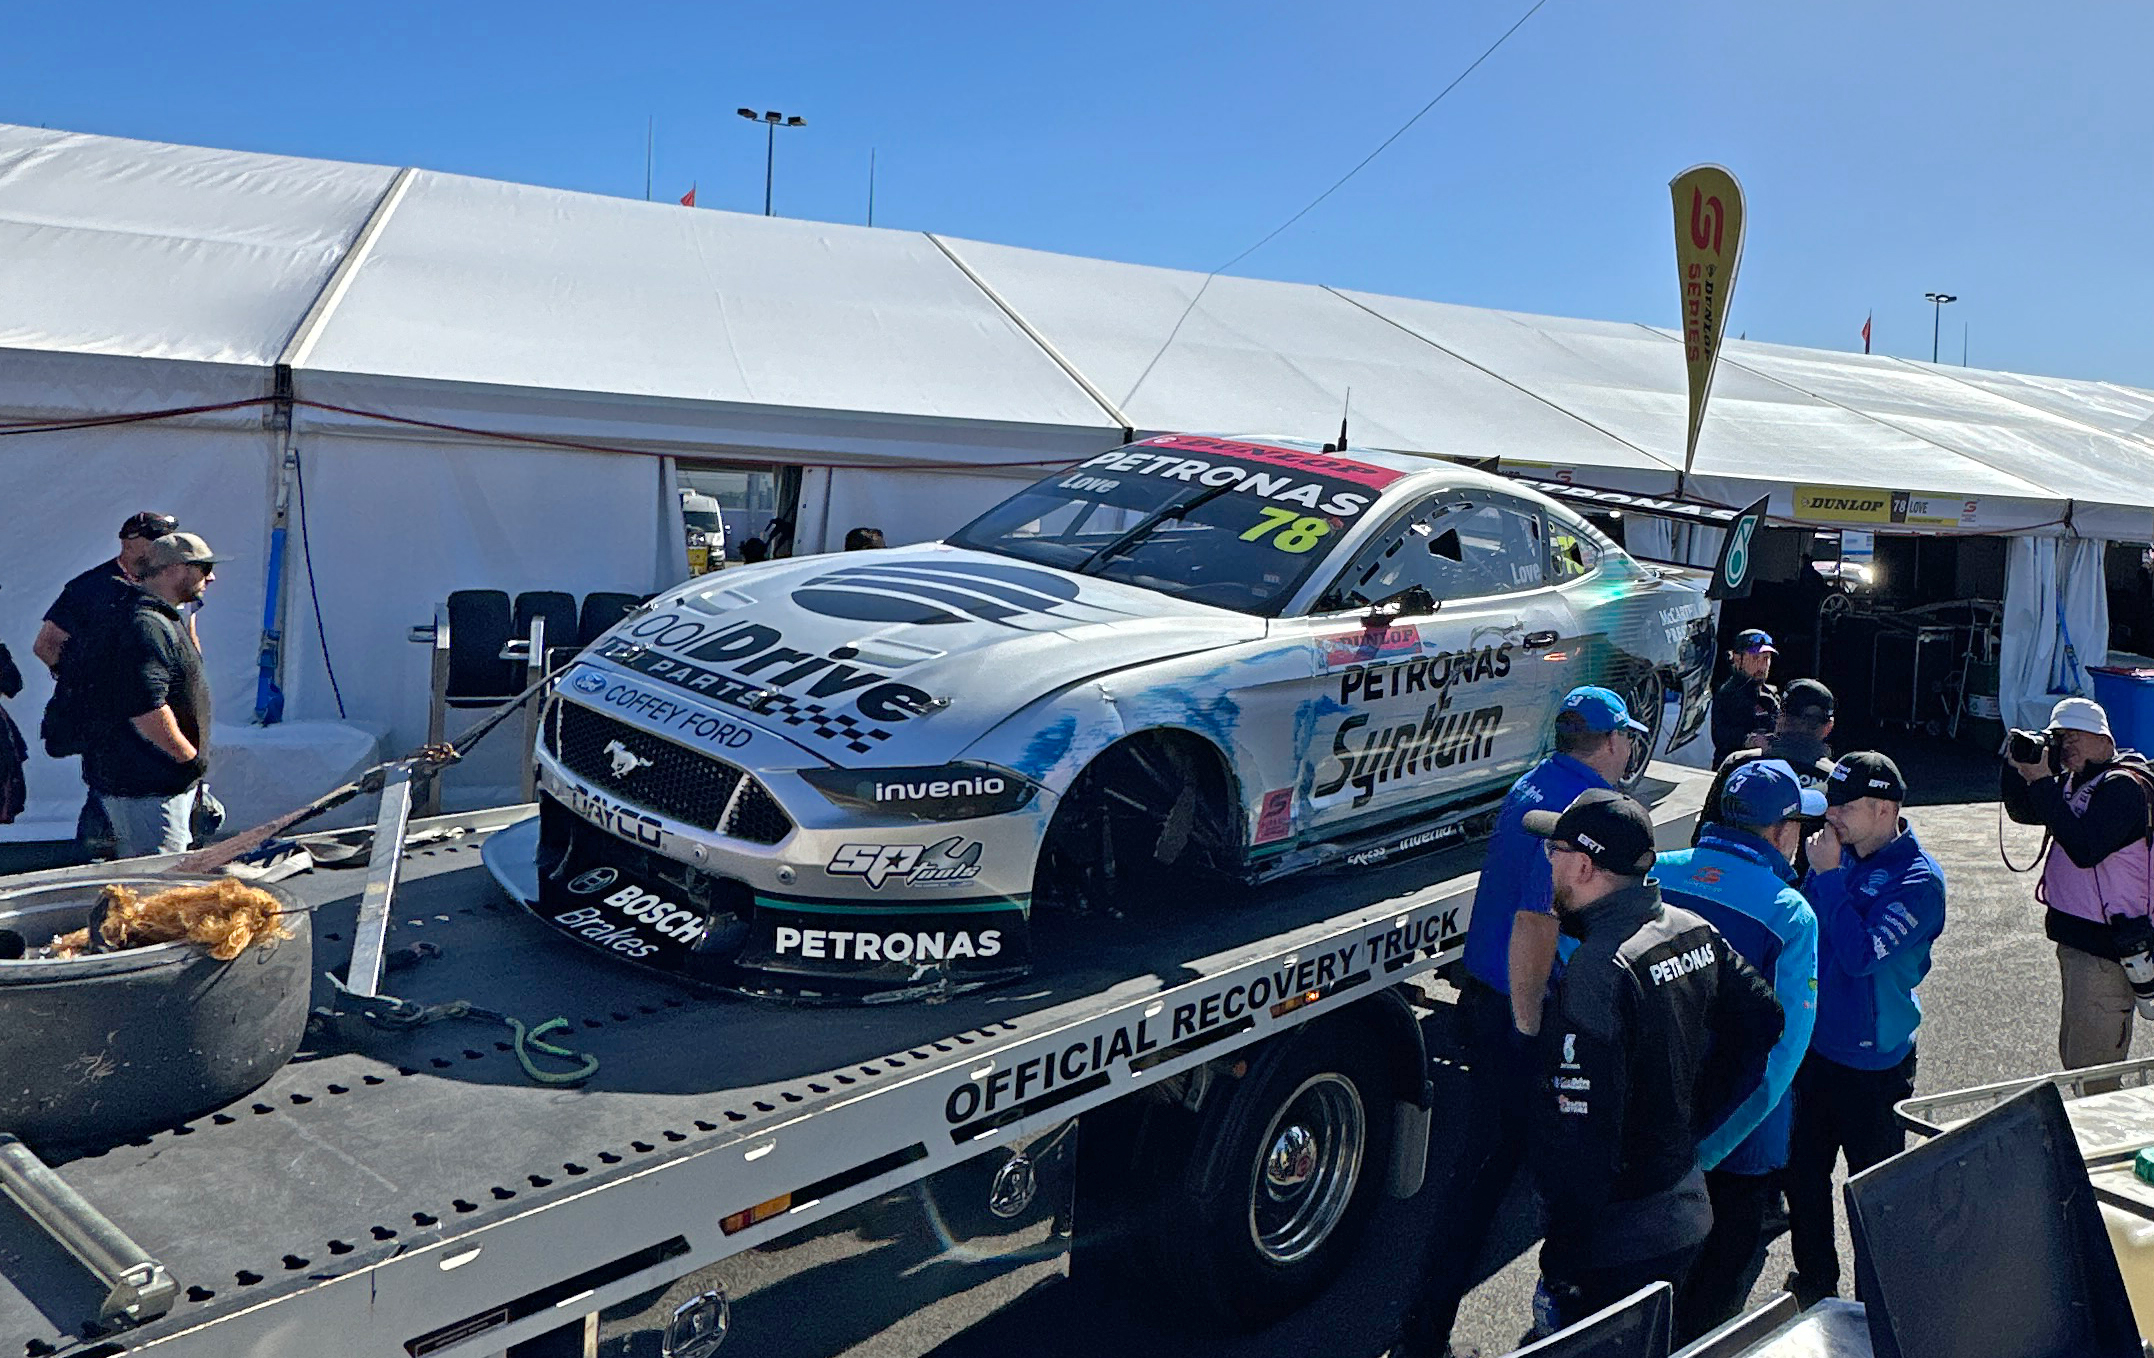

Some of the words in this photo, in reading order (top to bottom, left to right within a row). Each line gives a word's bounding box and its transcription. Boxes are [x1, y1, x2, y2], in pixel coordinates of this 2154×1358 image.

[1687, 263, 1702, 361] SERIES
[1058, 472, 1120, 494] Love
[1080, 452, 1370, 517] PETRONAS
[1810, 497, 1885, 512] DUNLOP
[1893, 500, 1906, 513] 78
[1908, 501, 1929, 514] LOVE
[1239, 506, 1331, 554] 78
[1510, 562, 1541, 585] Love
[1339, 629, 1413, 651] DUNLOP
[648, 659, 766, 706] PARTS
[1340, 642, 1514, 705] PETRONAS
[604, 684, 686, 724] COFFEY
[683, 710, 753, 749] FORD
[1314, 696, 1503, 809] Syntium
[875, 777, 1004, 801] invenio
[567, 784, 674, 849] DAYCO
[554, 907, 659, 957] Brakes
[603, 885, 704, 943] BOSCH
[775, 927, 1001, 961] PETRONAS
[1650, 943, 1715, 986] PETRONAS
[945, 1019, 1158, 1124] OFFICIAL
[1172, 943, 1357, 1040] RECOVERY
[1365, 908, 1460, 964] TRUCK
